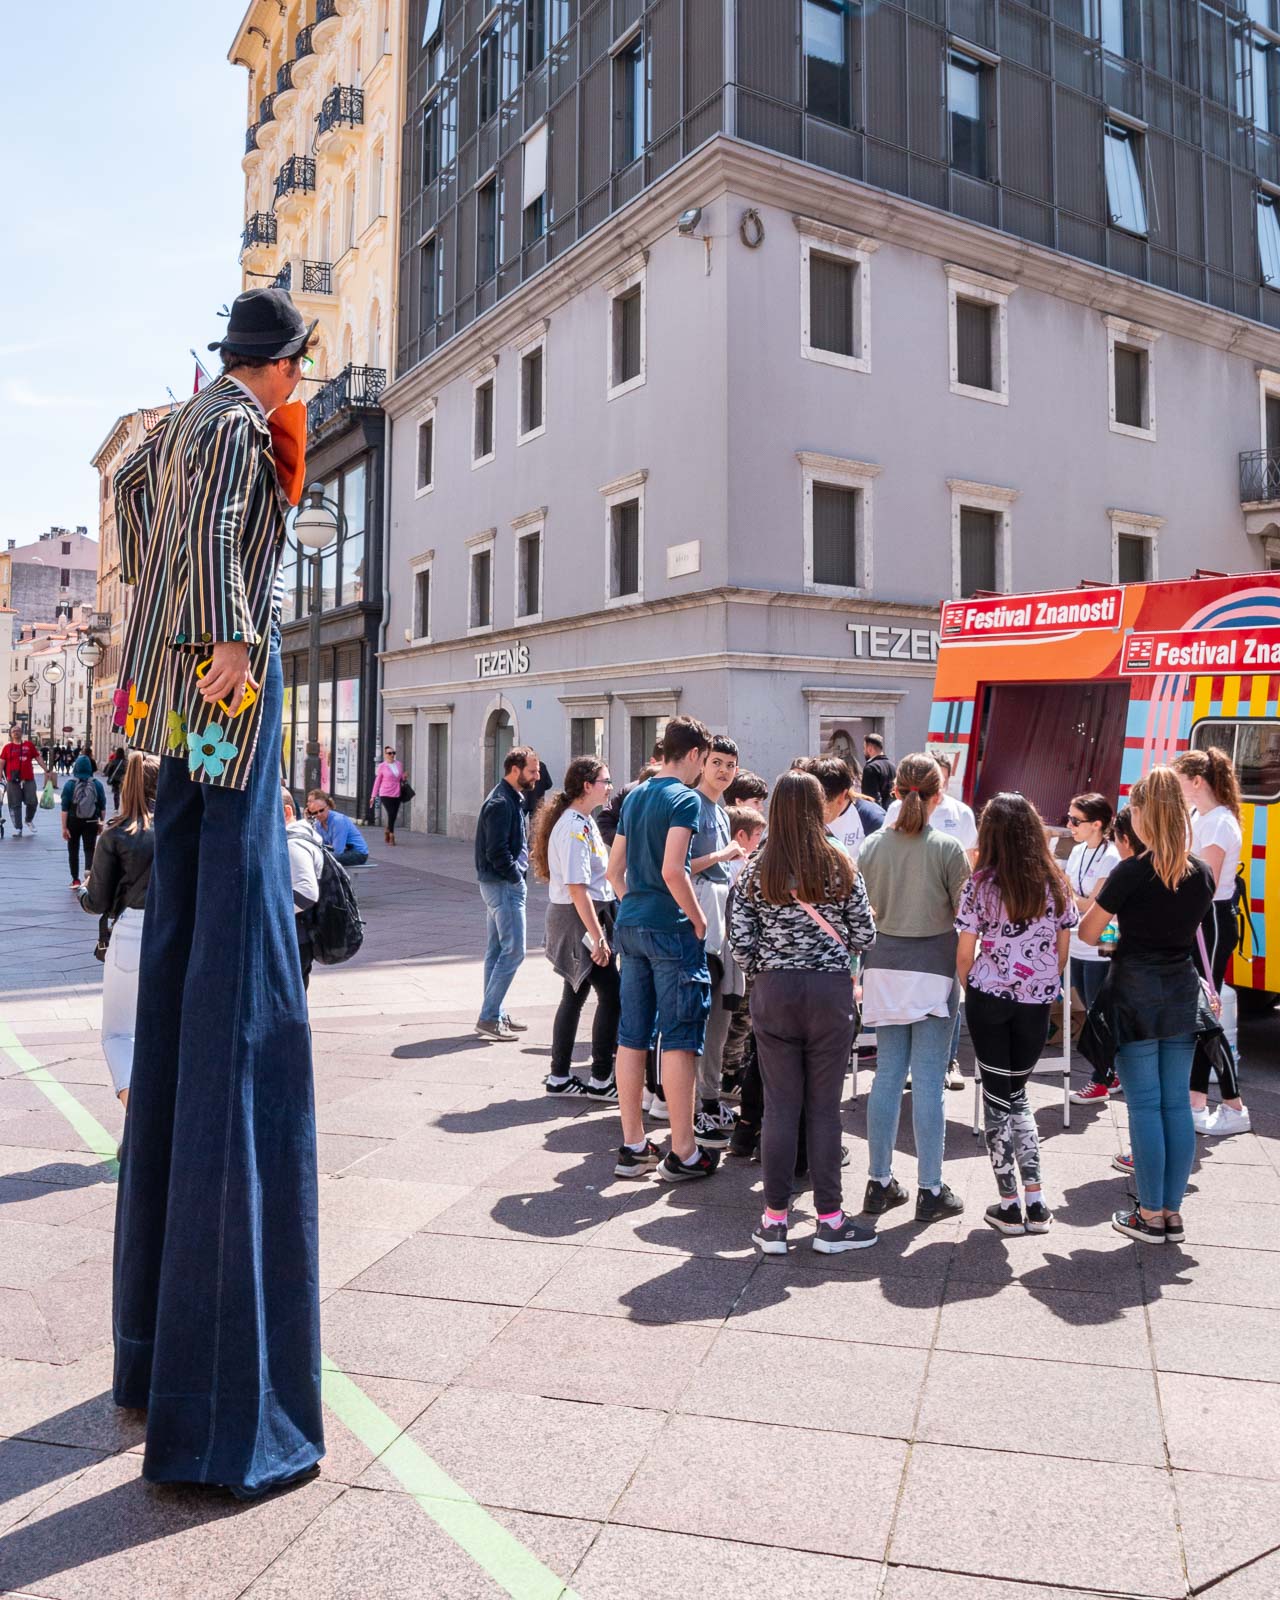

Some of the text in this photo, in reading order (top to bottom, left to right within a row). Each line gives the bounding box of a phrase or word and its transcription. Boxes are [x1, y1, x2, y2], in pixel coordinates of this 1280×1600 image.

[964, 604, 1032, 630] Festival
[1035, 597, 1116, 625] Znanosti
[1155, 639, 1237, 666] Festival
